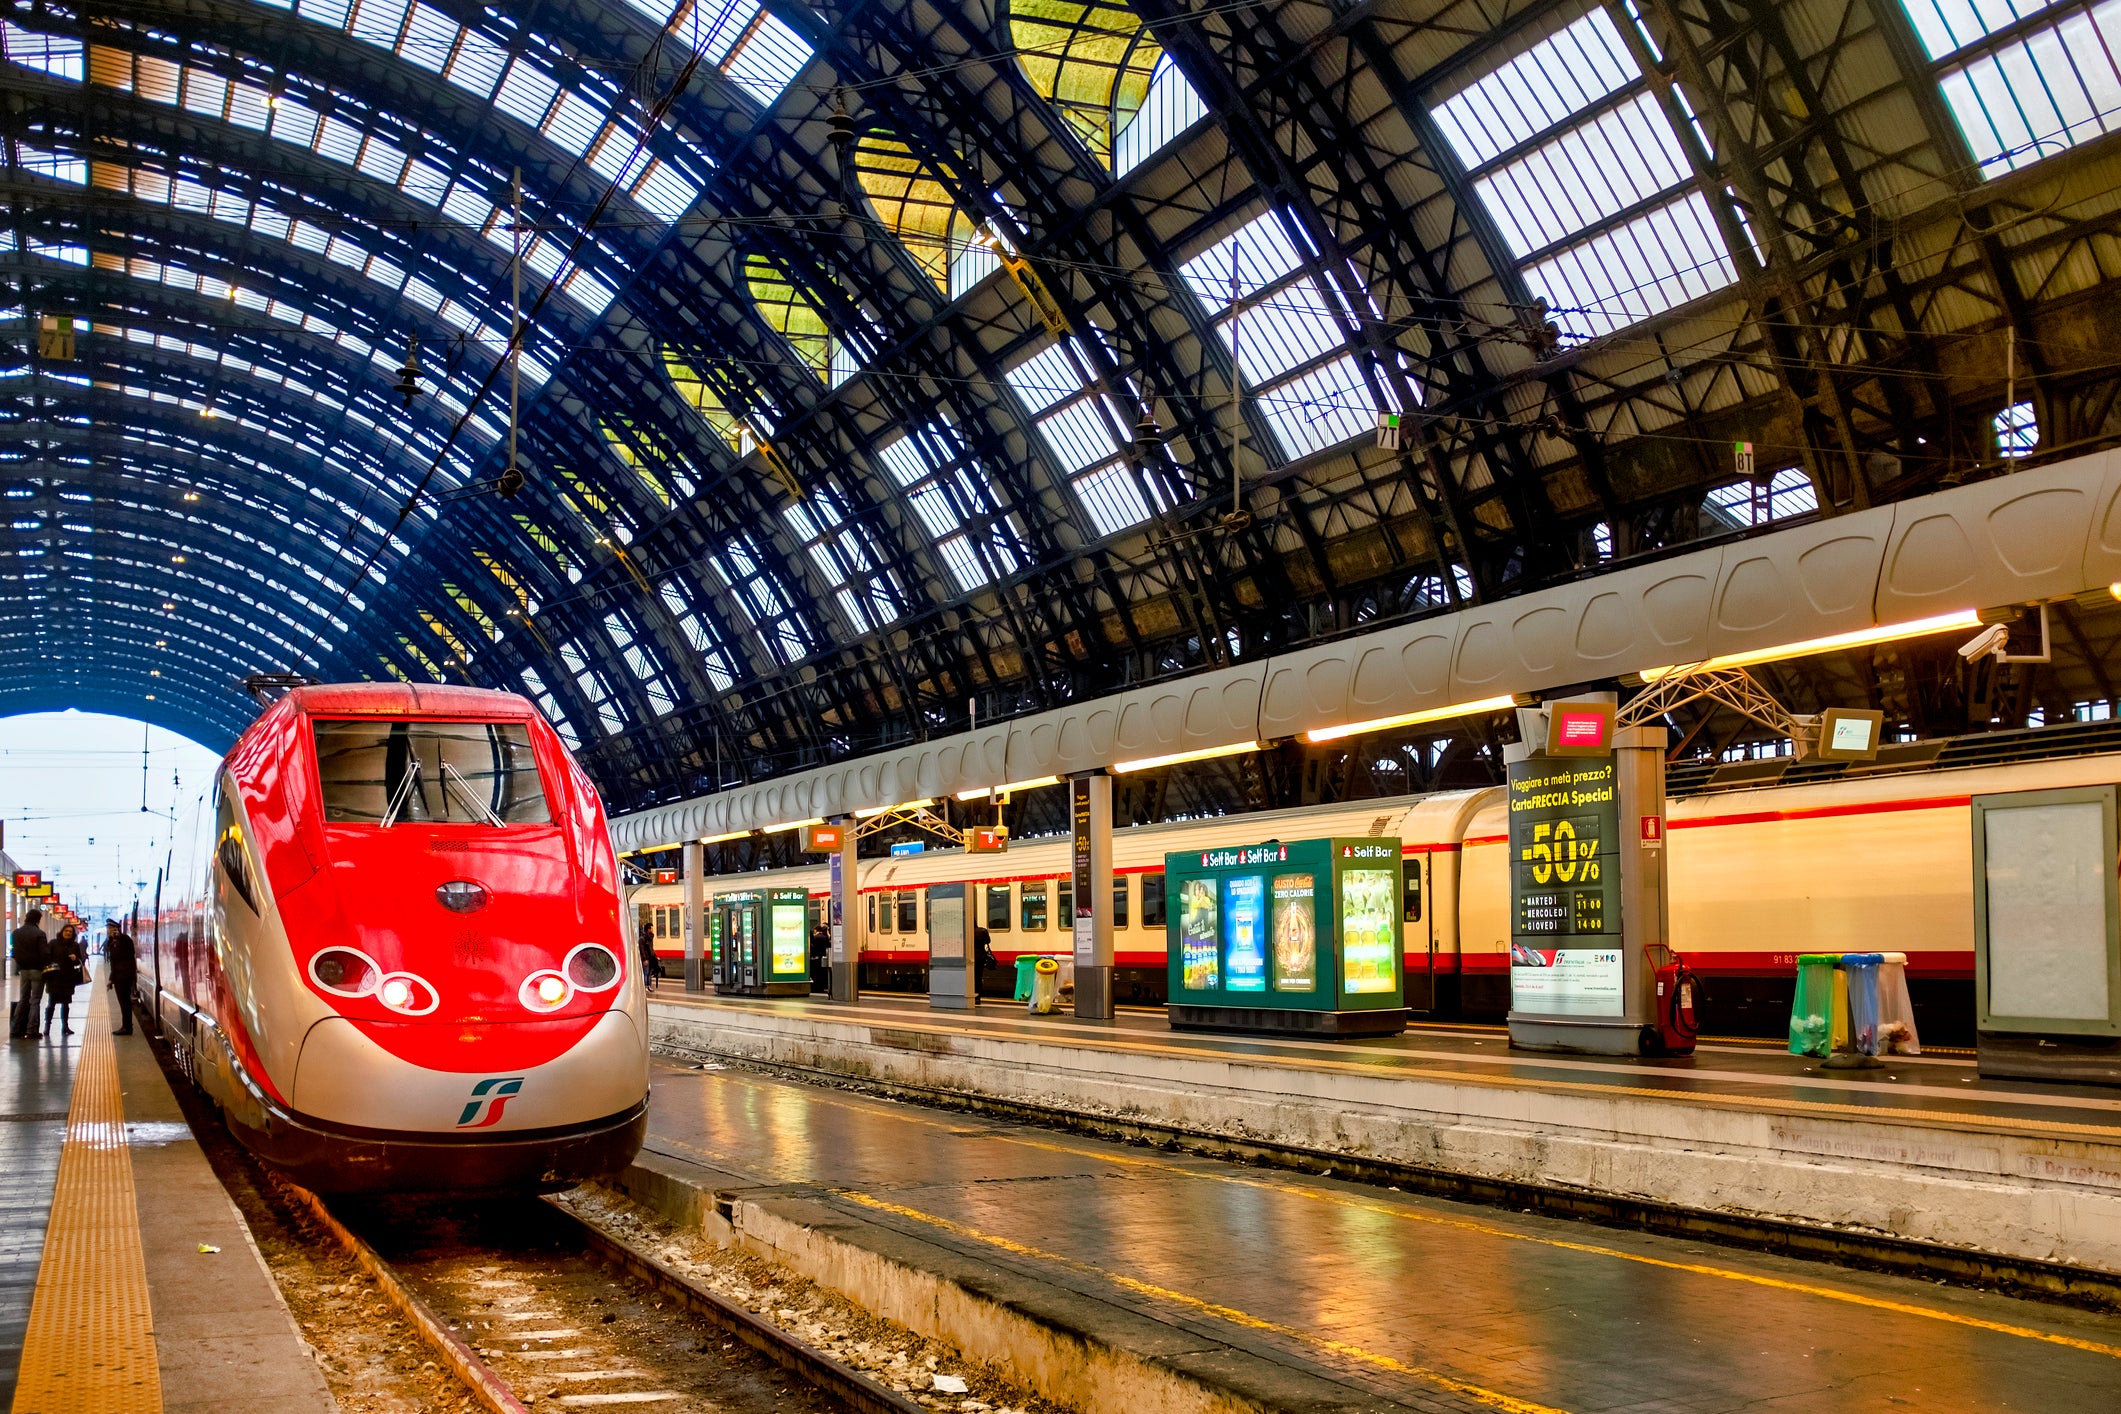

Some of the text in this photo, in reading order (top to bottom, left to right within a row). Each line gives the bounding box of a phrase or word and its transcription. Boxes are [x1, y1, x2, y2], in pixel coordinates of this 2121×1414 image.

[1380, 426, 1397, 448] 7T
[1738, 453, 1752, 472] 8T
[1511, 765, 1612, 793] Viaggiare a metà prezzo?
[1511, 786, 1613, 812] CartaFRECCIA Special
[987, 834, 993, 844] 9
[1209, 851, 1238, 867] Self Bar
[1247, 848, 1278, 864] Self Bar
[1354, 846, 1392, 858] Self Bar
[1522, 820, 1600, 884] -50%
[1274, 879, 1294, 889] GUSTO
[779, 892, 803, 900] Self Bar
[1274, 888, 1314, 899] ZERO CALORIE
[821, 900, 825, 911] 2
[892, 896, 897, 909] 2
[1594, 954, 1617, 962] EXPO
[1773, 954, 1782, 964] 91
[1784, 954, 1793, 964] 83
[1791, 1133, 1831, 1150] Vietato
[2045, 1160, 2064, 1175] Do
[2069, 1166, 2094, 1178] not
